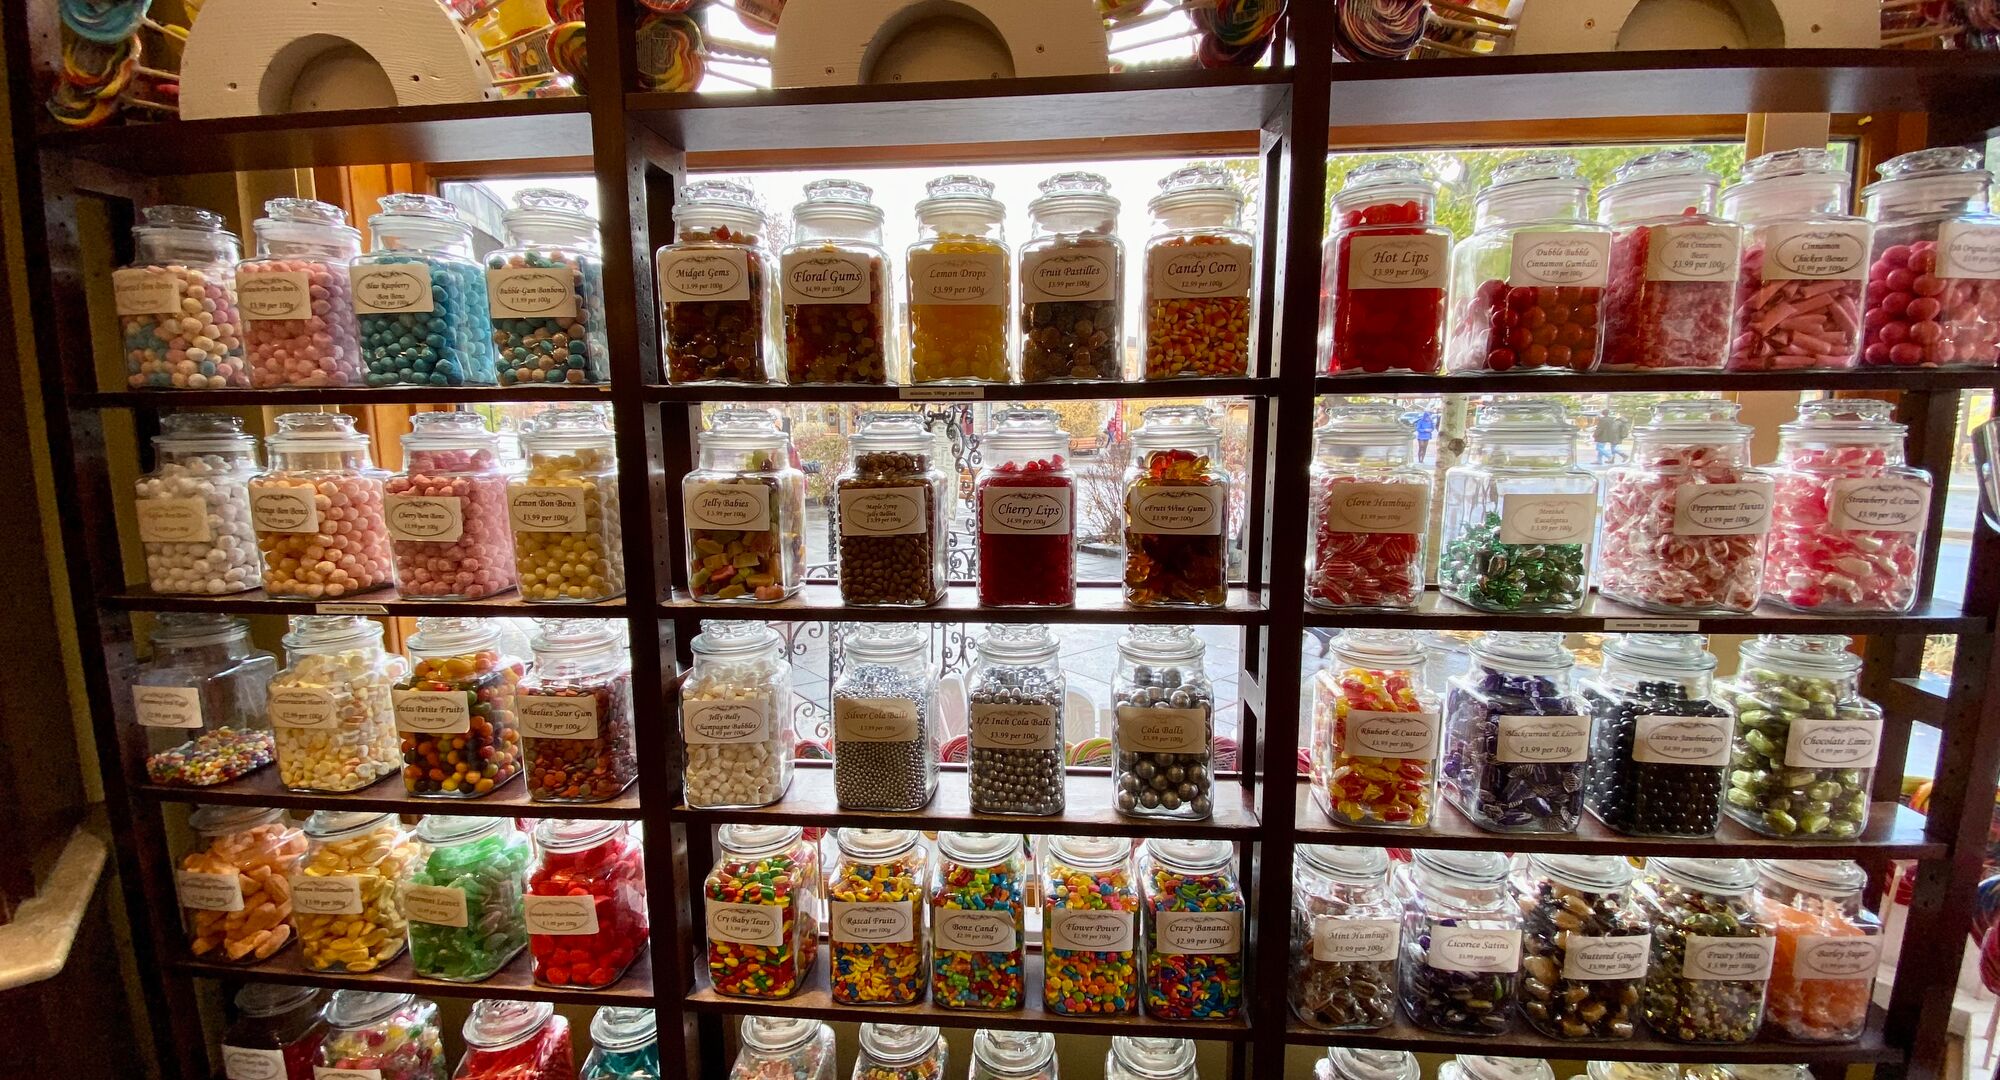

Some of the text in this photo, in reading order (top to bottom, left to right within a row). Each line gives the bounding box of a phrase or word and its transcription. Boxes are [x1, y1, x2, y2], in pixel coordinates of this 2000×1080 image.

[1801, 242, 1840, 250] Cinnamon
[1536, 248, 1589, 256] Dubble Bubble
[1373, 251, 1429, 264] Hot Lips
[1793, 254, 1848, 264] Chicken Bones
[1167, 261, 1237, 275] Candy Corn
[1527, 260, 1598, 269] Cinnamon Gumballs
[1693, 262, 1706, 270] per
[1709, 260, 1726, 269] 100g
[677, 269, 730, 278] Midget Gems
[930, 269, 986, 280] Lemon Drops
[1040, 266, 1100, 277] Fruit Pastilles
[1396, 270, 1408, 278] per
[1410, 268, 1429, 278] 100g
[794, 271, 861, 283] Floral Gums
[381, 282, 409, 291] Raspberry
[1076, 280, 1090, 288] 100g
[933, 286, 985, 296] $3.99 per 100g
[703, 499, 749, 508] Jelly Babies
[1346, 499, 1416, 510] Clove Humbugs
[1847, 496, 1888, 506] Strawberry
[998, 503, 1060, 517] Cherry Lips
[1187, 505, 1207, 513] Gums
[1692, 503, 1737, 513] Peppermint
[399, 512, 416, 520] Cherry
[553, 514, 568, 522] 100g
[417, 705, 437, 713] Petite
[522, 708, 592, 719] Wheelies Sour Gum
[845, 711, 908, 720] Silver Cola Balls
[977, 717, 1051, 726] 1/2 Inch Cola Balls
[1141, 726, 1183, 734] Cola Balls
[1361, 728, 1389, 736] Rhubarb
[1401, 729, 1426, 737] Custard
[1505, 729, 1550, 738] Blackcurrant
[1650, 733, 1723, 742] Licorice Jawbreakers
[1803, 736, 1871, 746] Chocolate Limes
[1555, 746, 1572, 755] 100g
[717, 915, 770, 926] Cry Baby Tears
[847, 916, 871, 924] Rascal
[974, 924, 999, 933] Candy
[1066, 923, 1121, 932] Flower Power
[1170, 925, 1193, 934] Crazy
[1329, 932, 1389, 941] Mint Humbugs
[1209, 938, 1225, 946] 100g
[1447, 940, 1509, 950] Licorice Satins
[1580, 952, 1642, 961] Buttered Ginger
[1816, 950, 1868, 959] Barley Sugar
